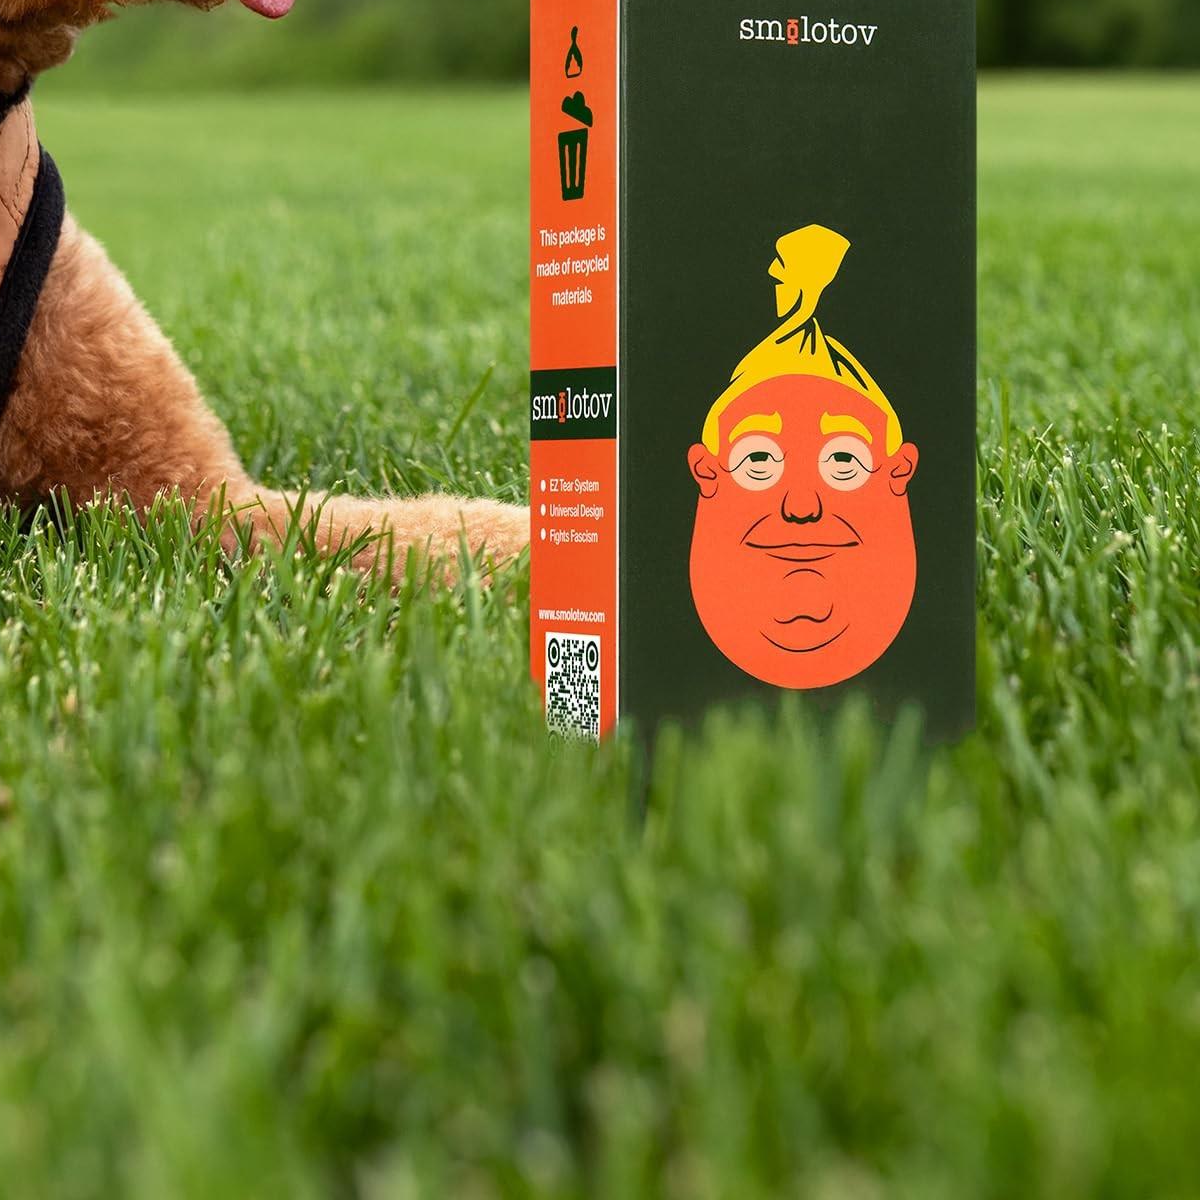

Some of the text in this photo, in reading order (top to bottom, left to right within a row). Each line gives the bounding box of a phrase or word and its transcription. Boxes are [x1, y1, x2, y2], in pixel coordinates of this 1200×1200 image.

[540, 224, 606, 248] This package is
[536, 253, 609, 277] made of recycled
[552, 286, 592, 306] materials
[549, 478, 600, 494] EZ Tear System
[549, 503, 604, 521] Universal Design
[549, 528, 599, 545] Fights Fascism
[538, 608, 606, 623] www.smolotov.com
